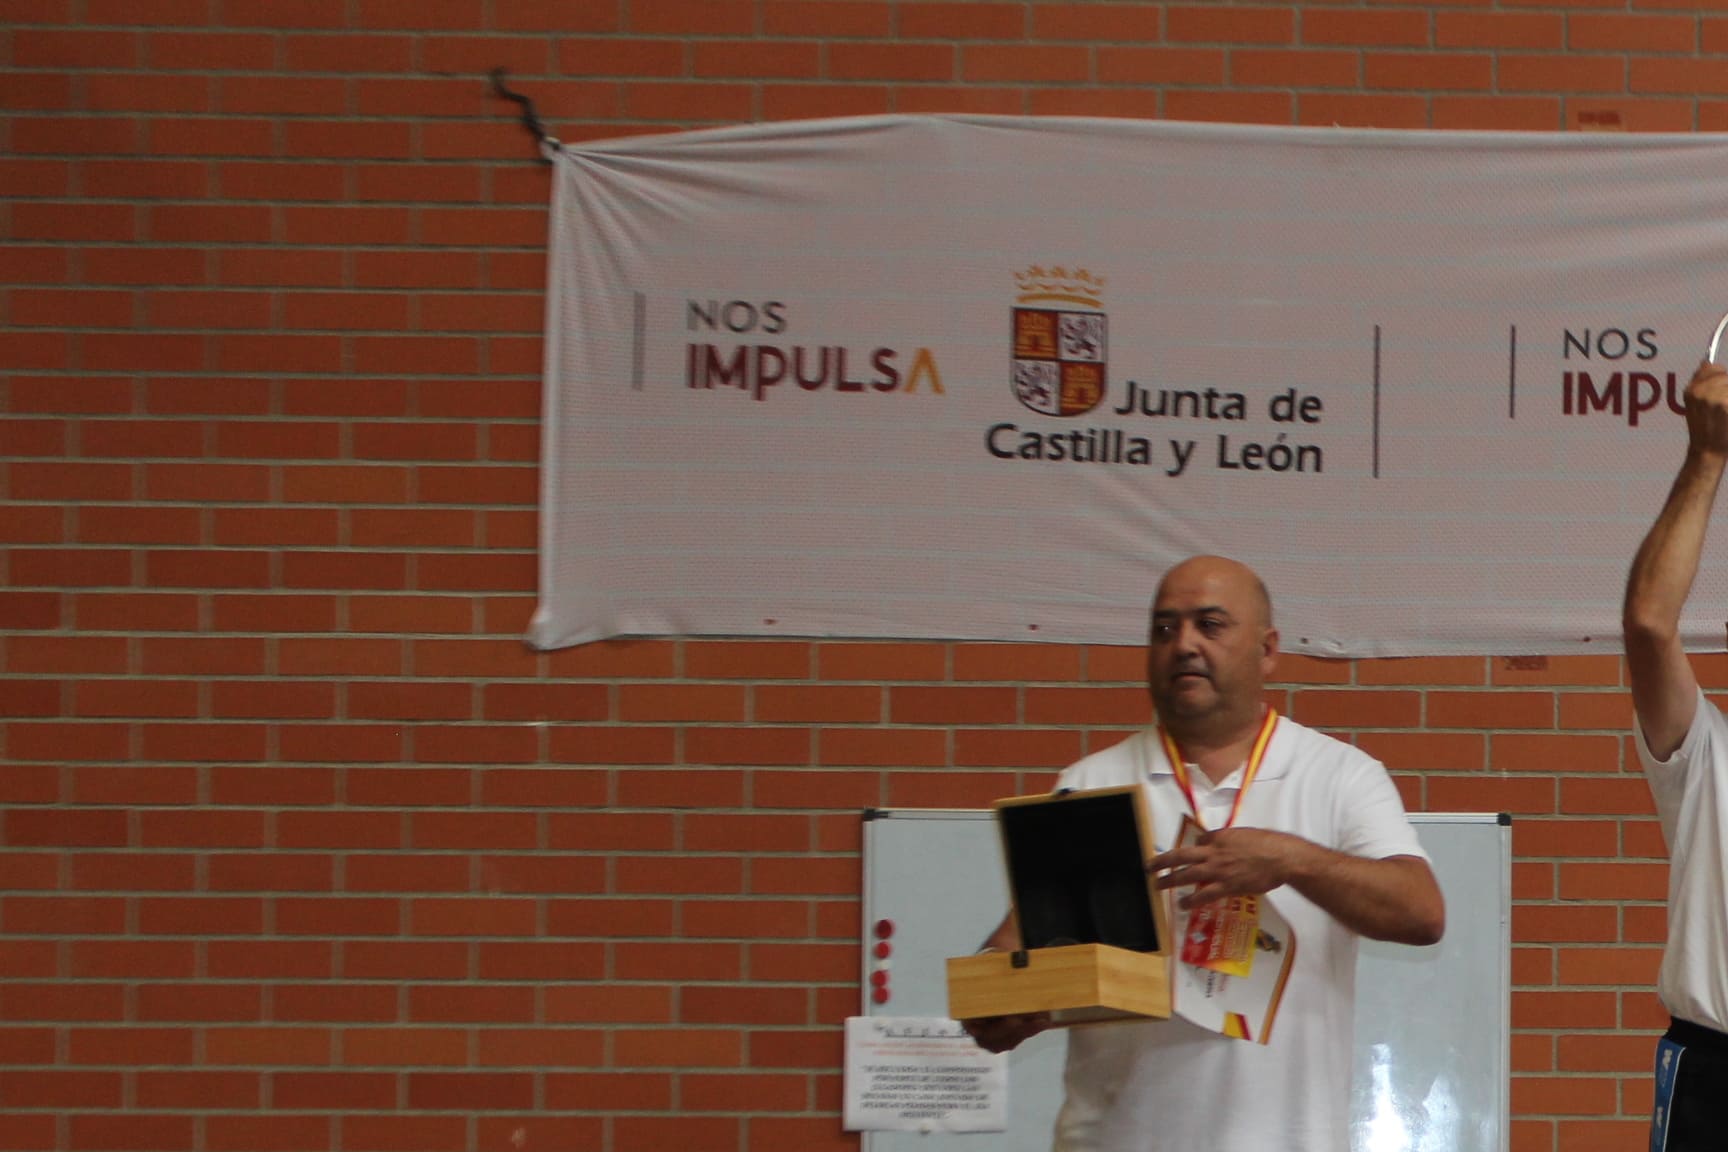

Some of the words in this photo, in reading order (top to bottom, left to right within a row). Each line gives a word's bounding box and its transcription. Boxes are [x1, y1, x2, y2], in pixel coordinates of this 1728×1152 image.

[686, 300, 786, 333] NOS
[1563, 328, 1658, 360] NOS
[686, 343, 945, 401] IMPULSA
[1114, 380, 1247, 420] Junta
[1269, 388, 1324, 423] de
[984, 423, 1151, 465] Castilla
[1167, 439, 1197, 477] y
[1217, 433, 1324, 473] León
